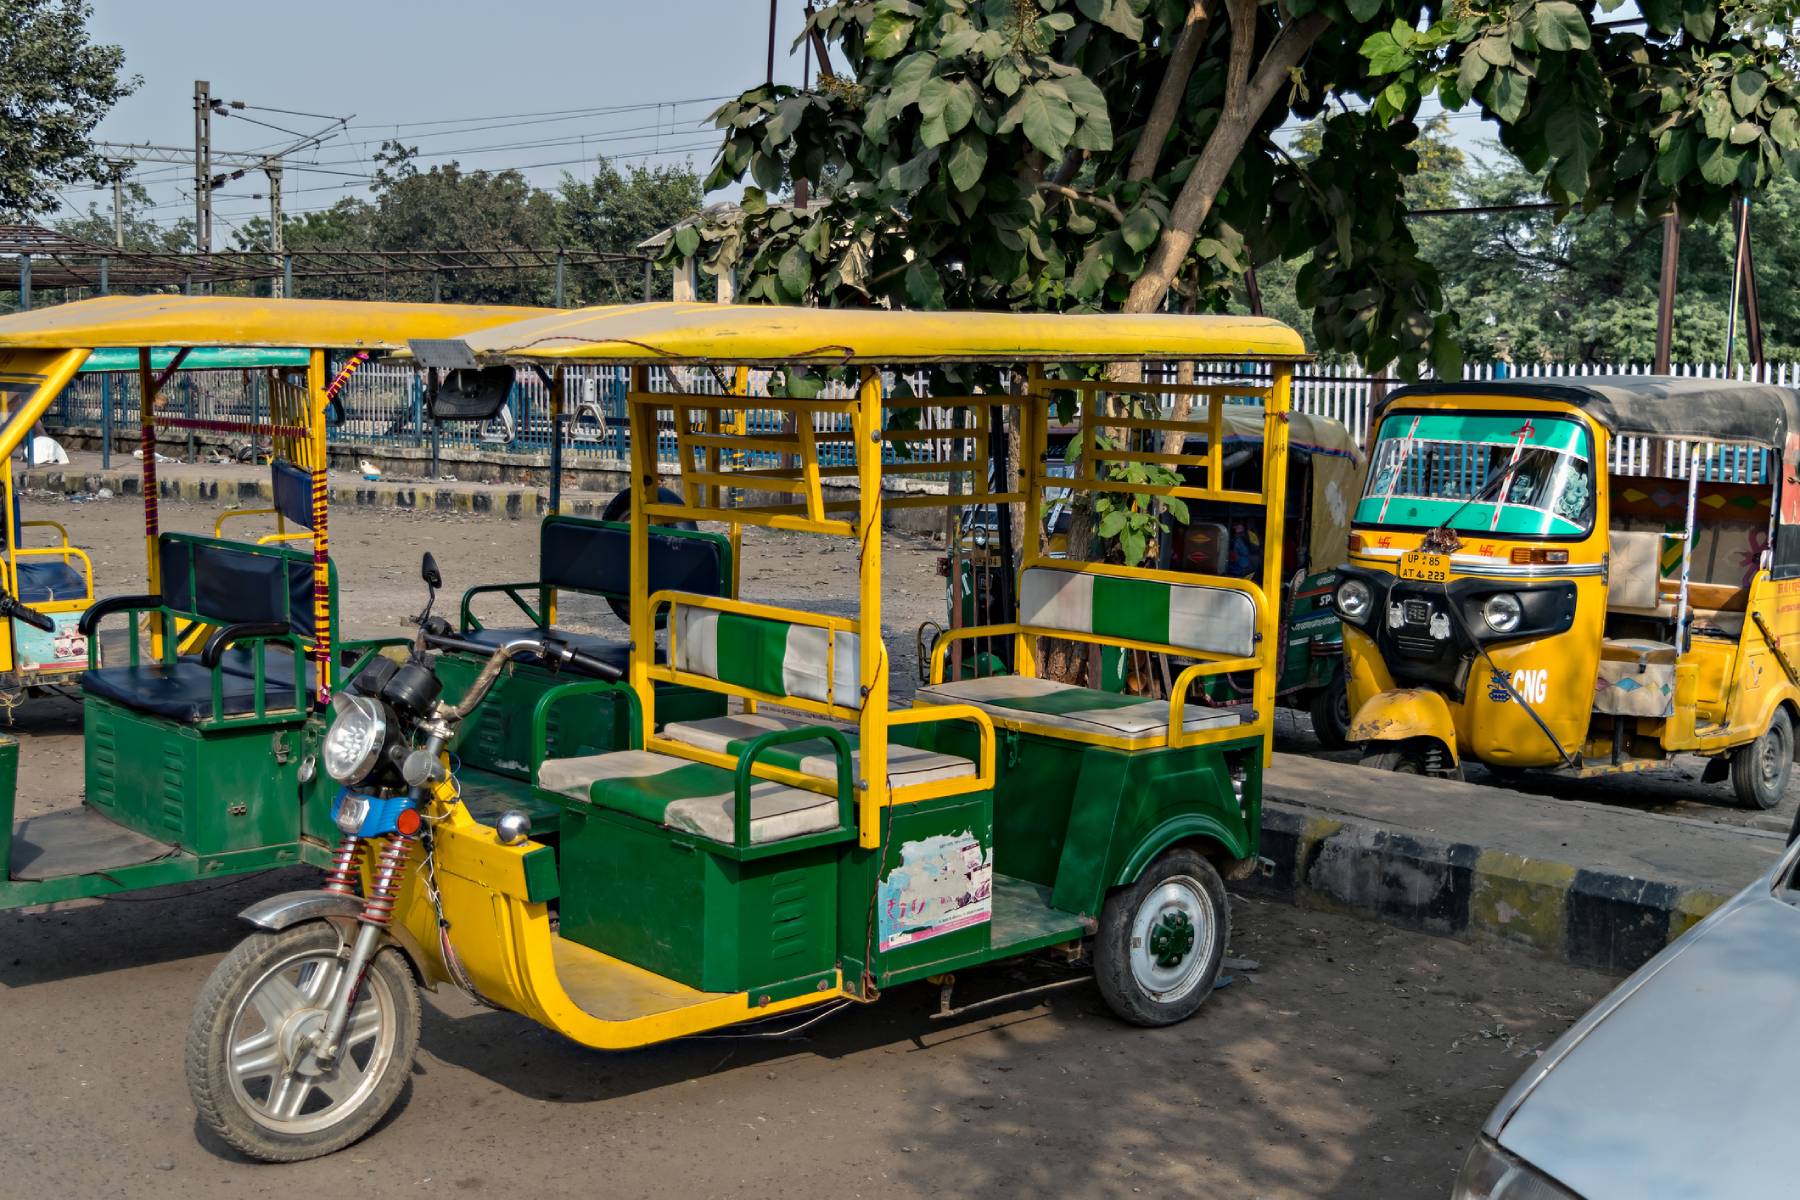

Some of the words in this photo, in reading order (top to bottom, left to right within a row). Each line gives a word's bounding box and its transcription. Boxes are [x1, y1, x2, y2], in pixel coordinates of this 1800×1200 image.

[1408, 554, 1419, 563] UP
[1429, 557, 1440, 566] 85
[1403, 568, 1415, 577] AT
[1512, 669, 1548, 704] CNG
